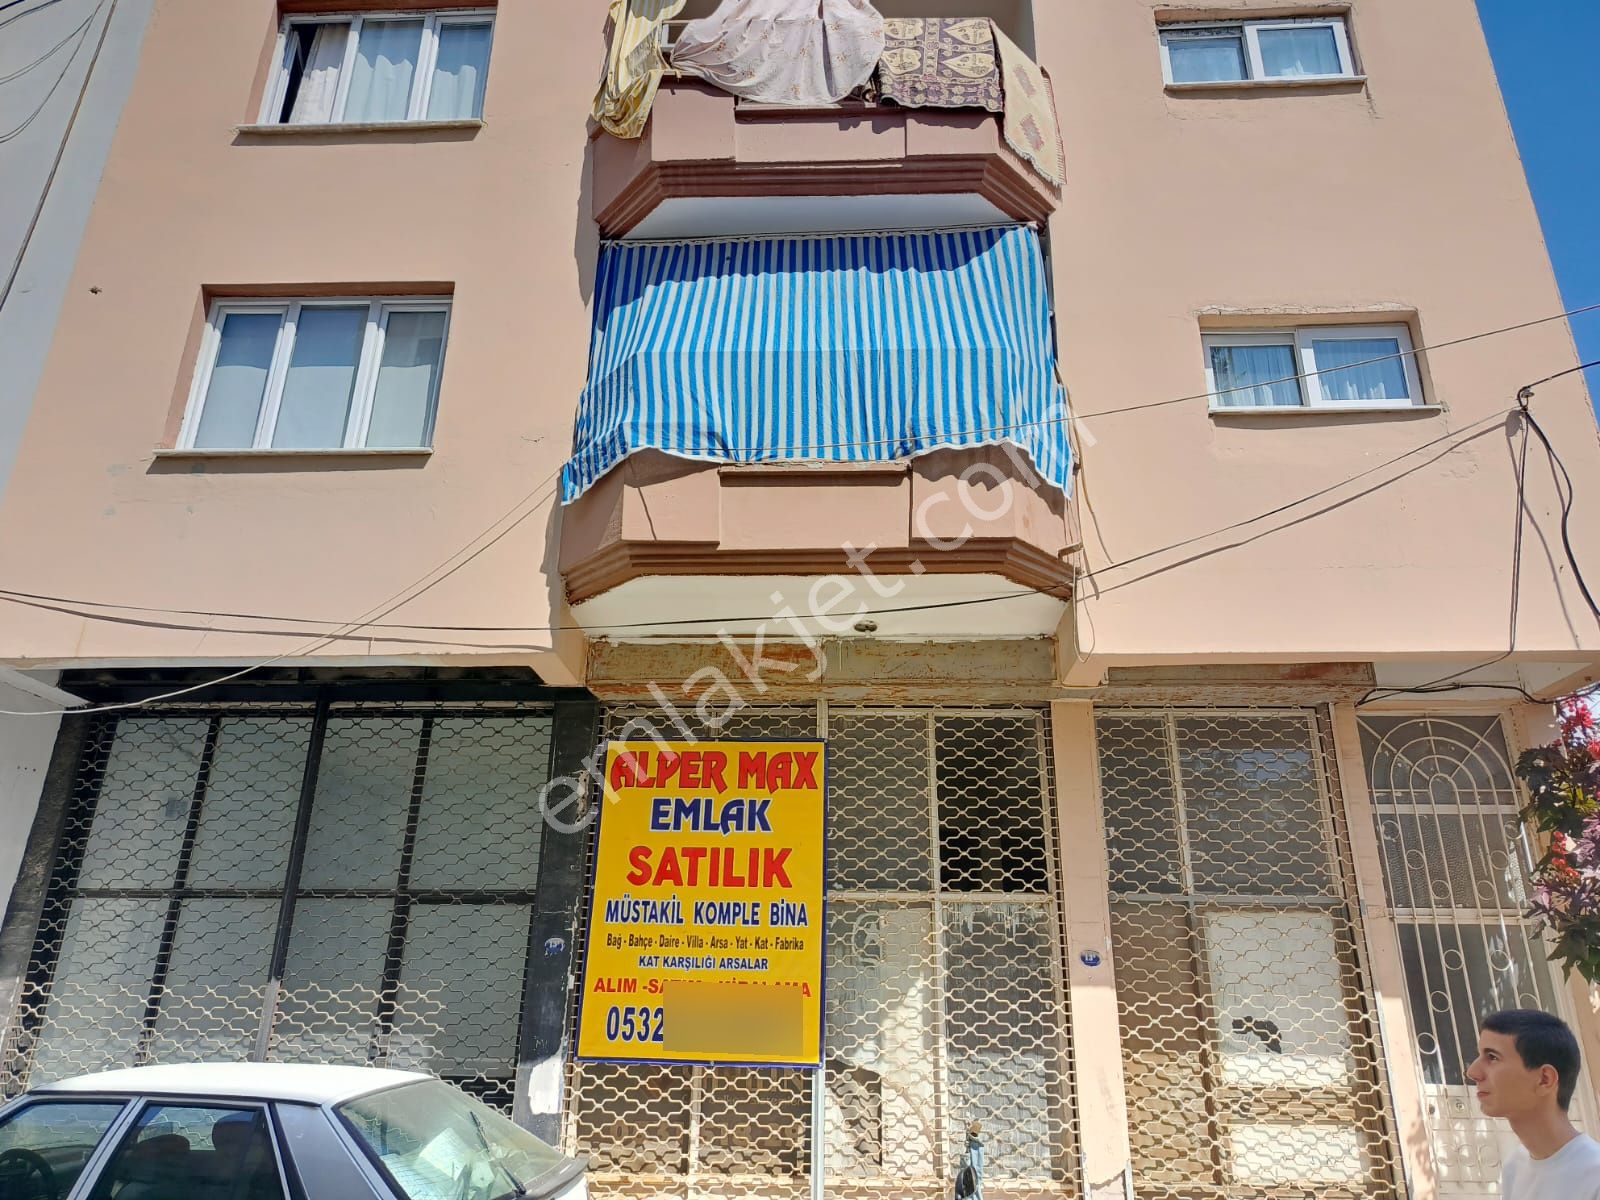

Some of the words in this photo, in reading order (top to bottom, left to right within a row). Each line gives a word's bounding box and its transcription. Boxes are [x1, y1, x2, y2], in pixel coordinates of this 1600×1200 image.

[610, 751, 728, 794] ALPER
[737, 752, 819, 794] MAX
[651, 798, 772, 835] EMLAK
[626, 845, 793, 888] SATILIK
[605, 893, 684, 924] MÜSTAKİL
[693, 901, 760, 926] KOMPLE
[606, 933, 622, 949] Bağ
[628, 933, 653, 950] Bahçe
[659, 934, 680, 948] Daire
[686, 935, 704, 948] Villa
[710, 936, 728, 949] Arsa
[735, 936, 748, 949] Yat
[754, 936, 769, 950] Kat
[775, 936, 804, 950] Fabrika
[638, 955, 660, 968] KAT
[662, 955, 716, 971] KARŞILIĞI
[719, 957, 769, 970] ARSALAR
[593, 977, 637, 993] ALIM
